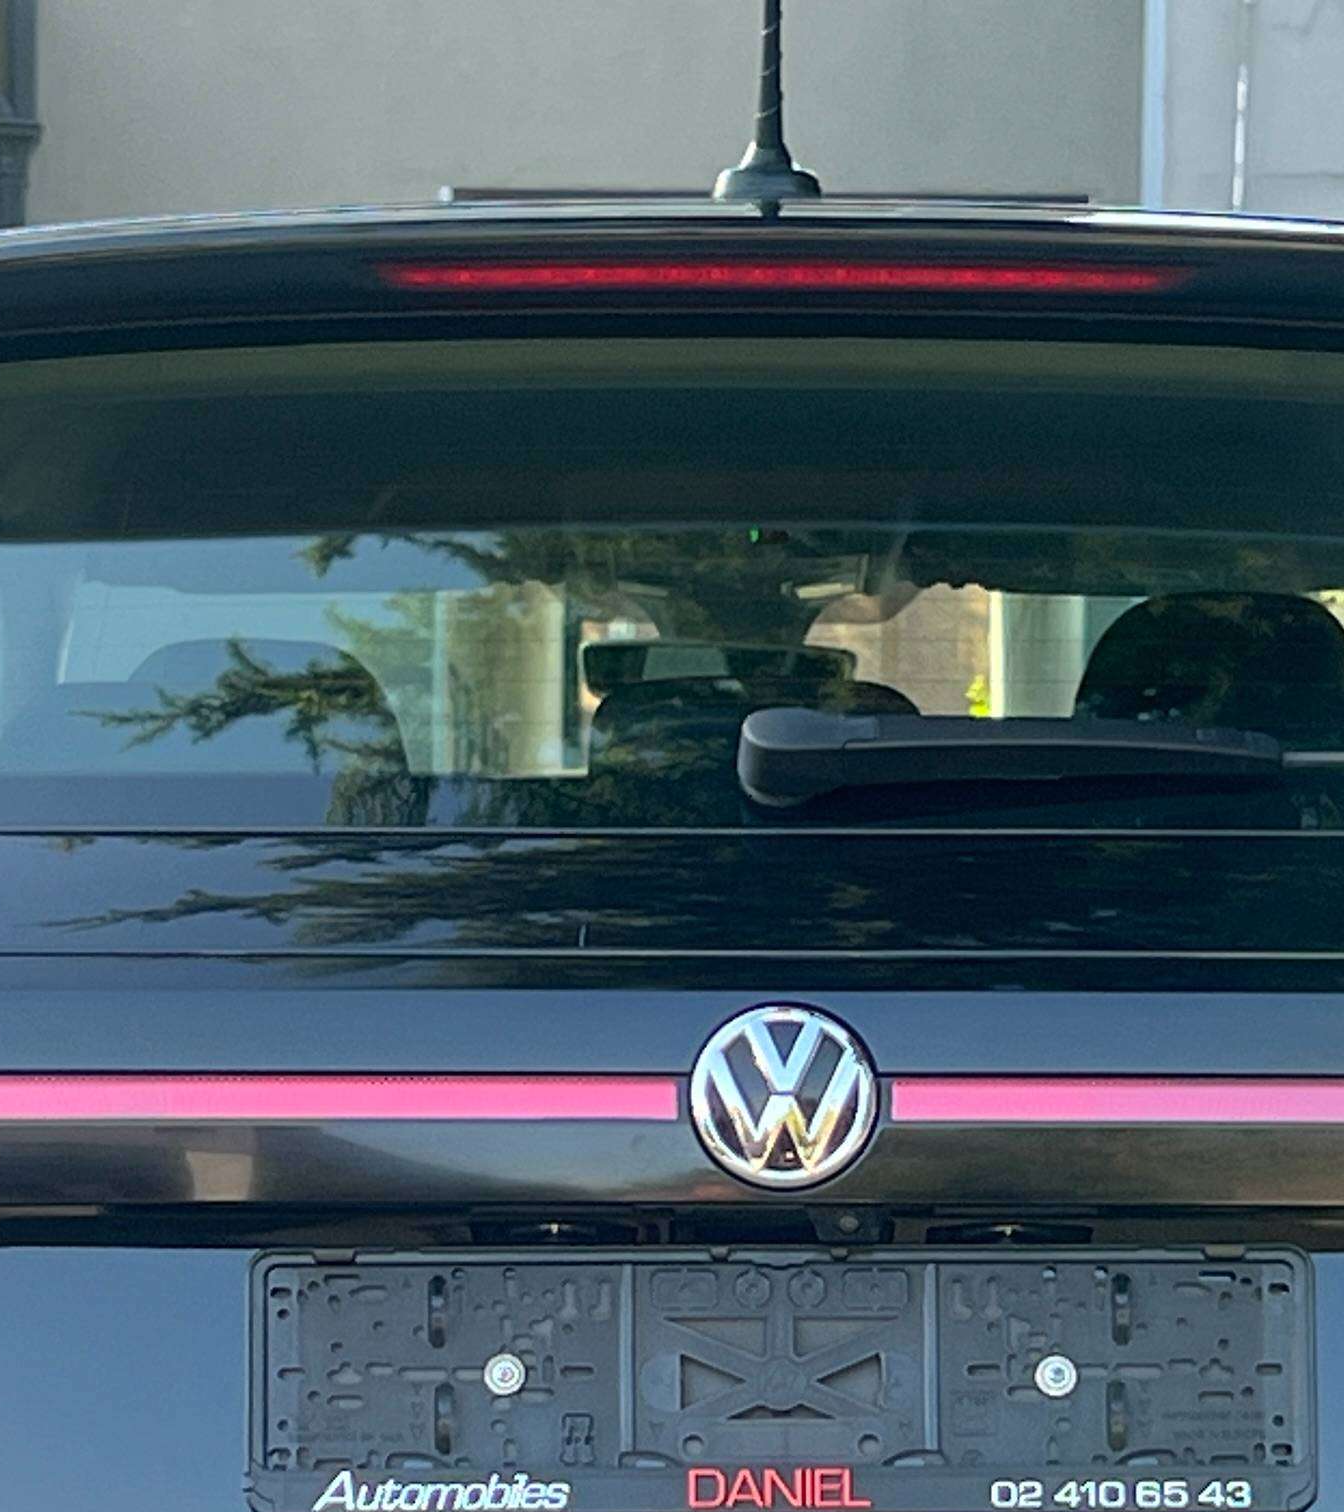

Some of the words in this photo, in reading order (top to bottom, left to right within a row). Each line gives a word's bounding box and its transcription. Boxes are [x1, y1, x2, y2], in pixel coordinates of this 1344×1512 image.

[704, 1015, 864, 1174] VW
[312, 1469, 570, 1512] Automobiles
[687, 1467, 872, 1509] DANIEL
[990, 1480, 1043, 1508] 02
[1053, 1480, 1126, 1508] 410
[1135, 1480, 1188, 1508] 65
[1197, 1480, 1252, 1508] 43
